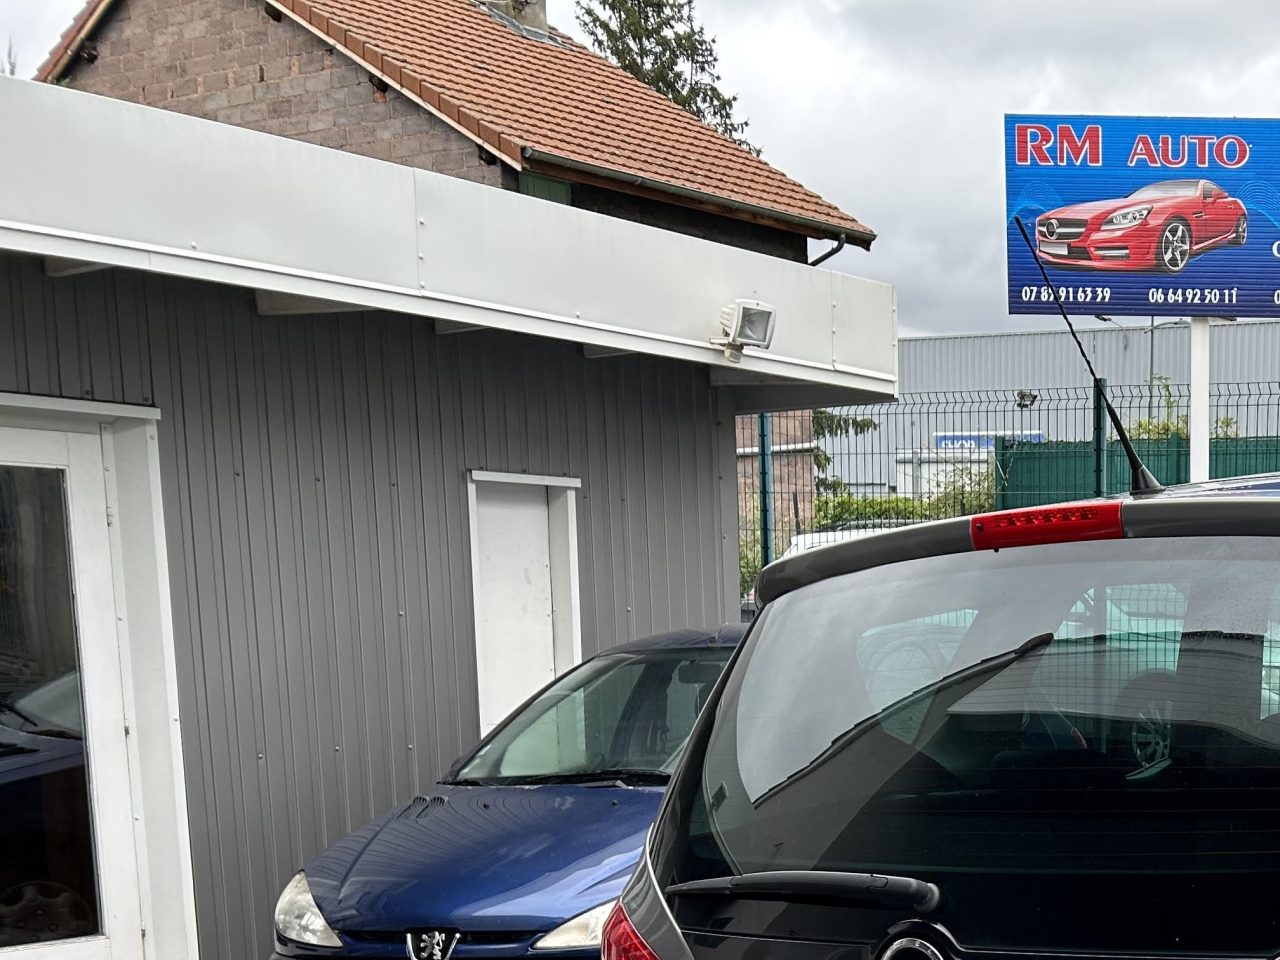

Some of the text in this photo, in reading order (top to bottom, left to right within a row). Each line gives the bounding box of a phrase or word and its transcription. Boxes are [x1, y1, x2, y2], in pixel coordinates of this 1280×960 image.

[1014, 123, 1250, 169] RM AUTO
[1021, 286, 1038, 301] 07
[1058, 286, 1073, 302] 91
[1077, 287, 1092, 302] 63
[1095, 287, 1111, 302] 39
[1148, 288, 1237, 304] 06 64 92 50 11
